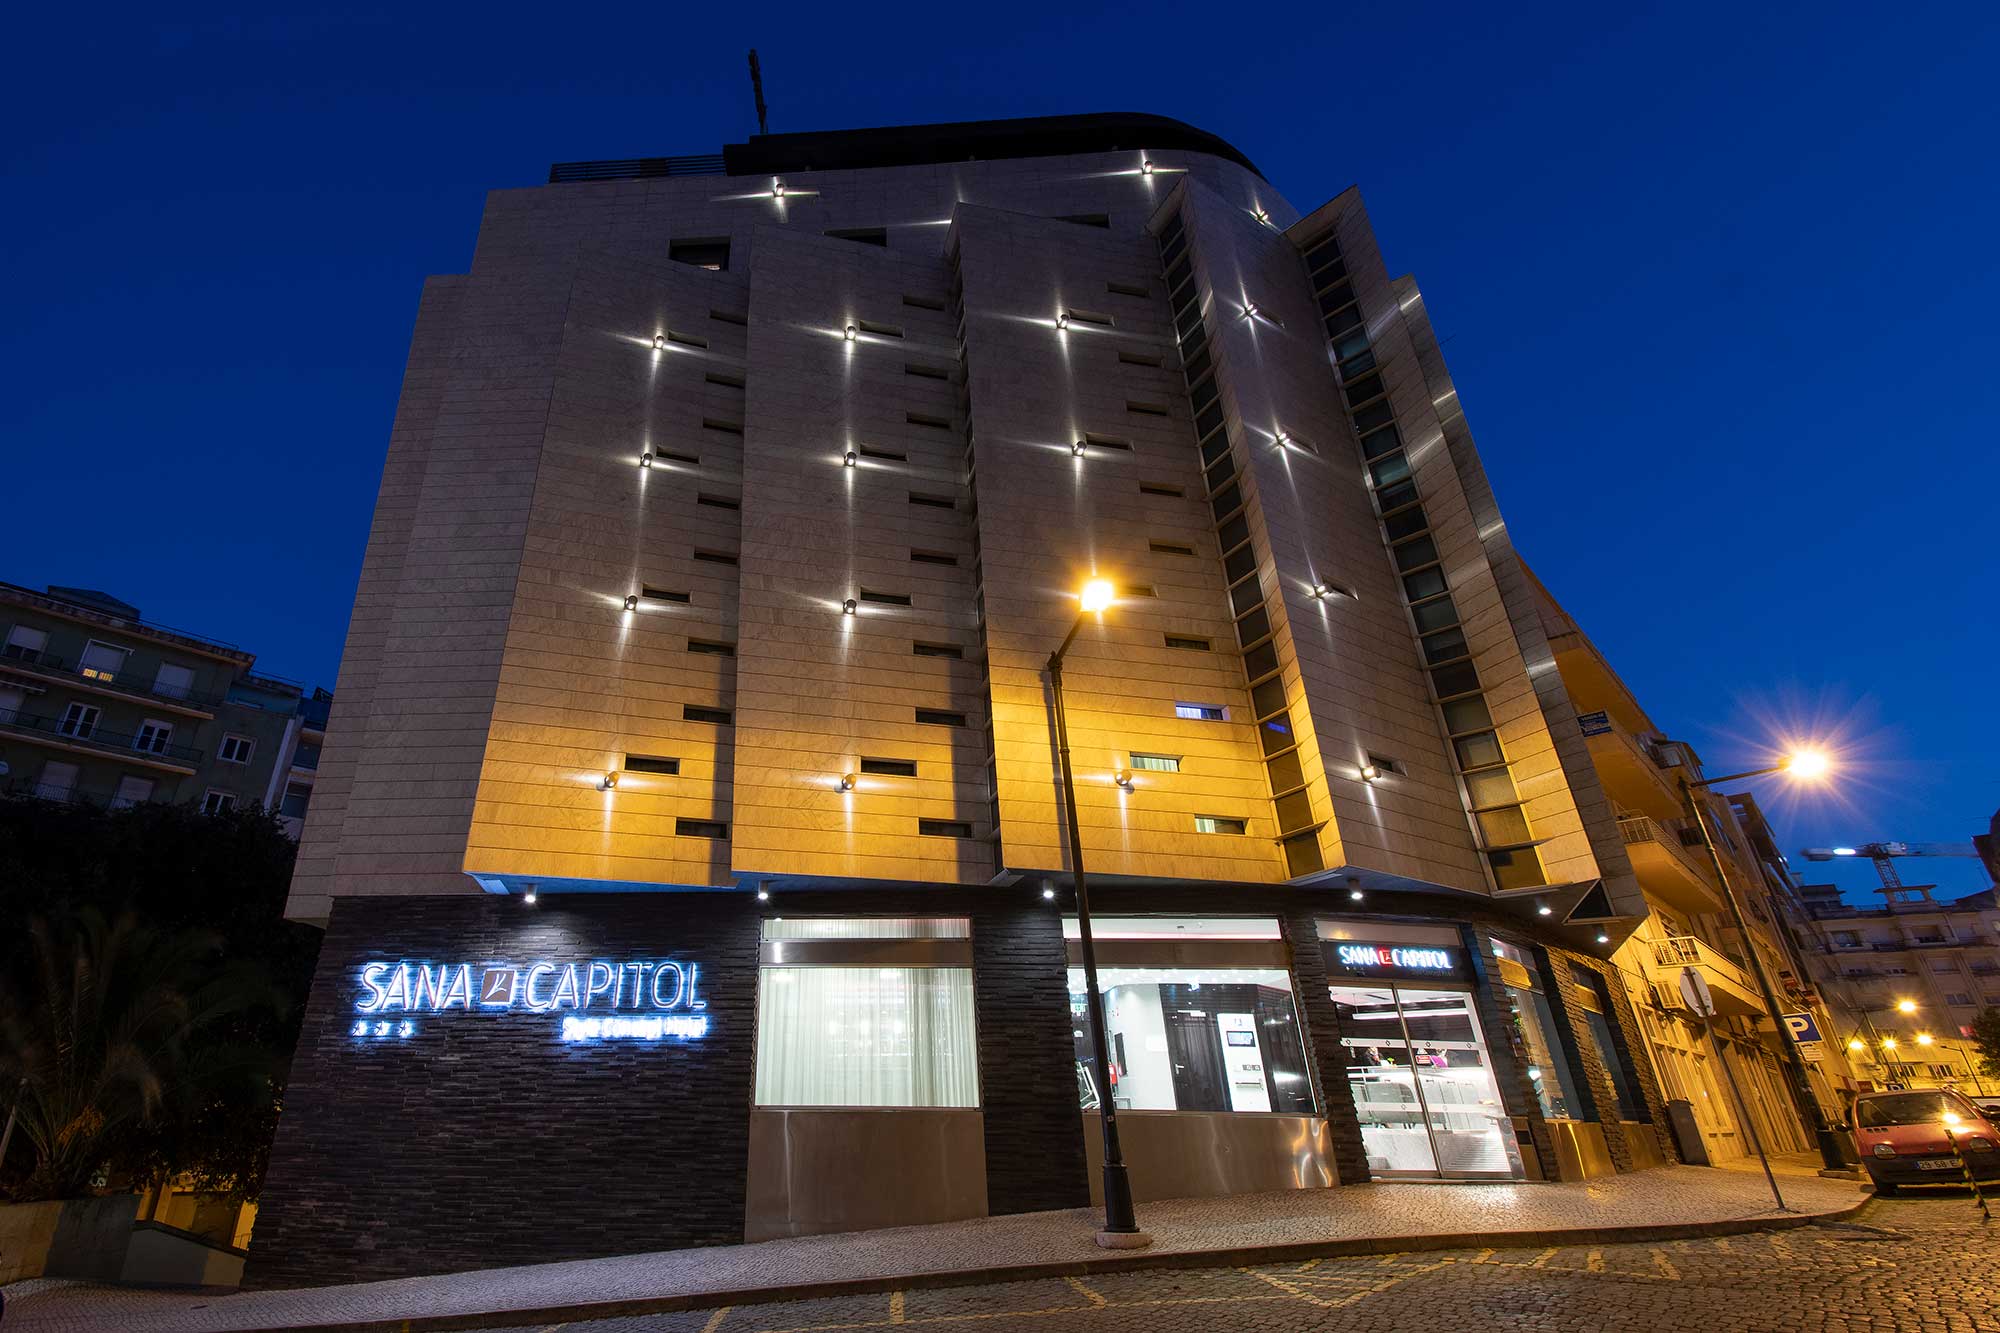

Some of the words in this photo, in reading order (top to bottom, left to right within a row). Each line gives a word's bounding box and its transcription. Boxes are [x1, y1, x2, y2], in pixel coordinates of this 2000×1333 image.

[1339, 945, 1380, 966] SANA
[1391, 947, 1453, 969] CAPITOL
[357, 963, 470, 1010] SANA
[523, 962, 706, 1010] CAPITOL
[1784, 1017, 1809, 1041] P
